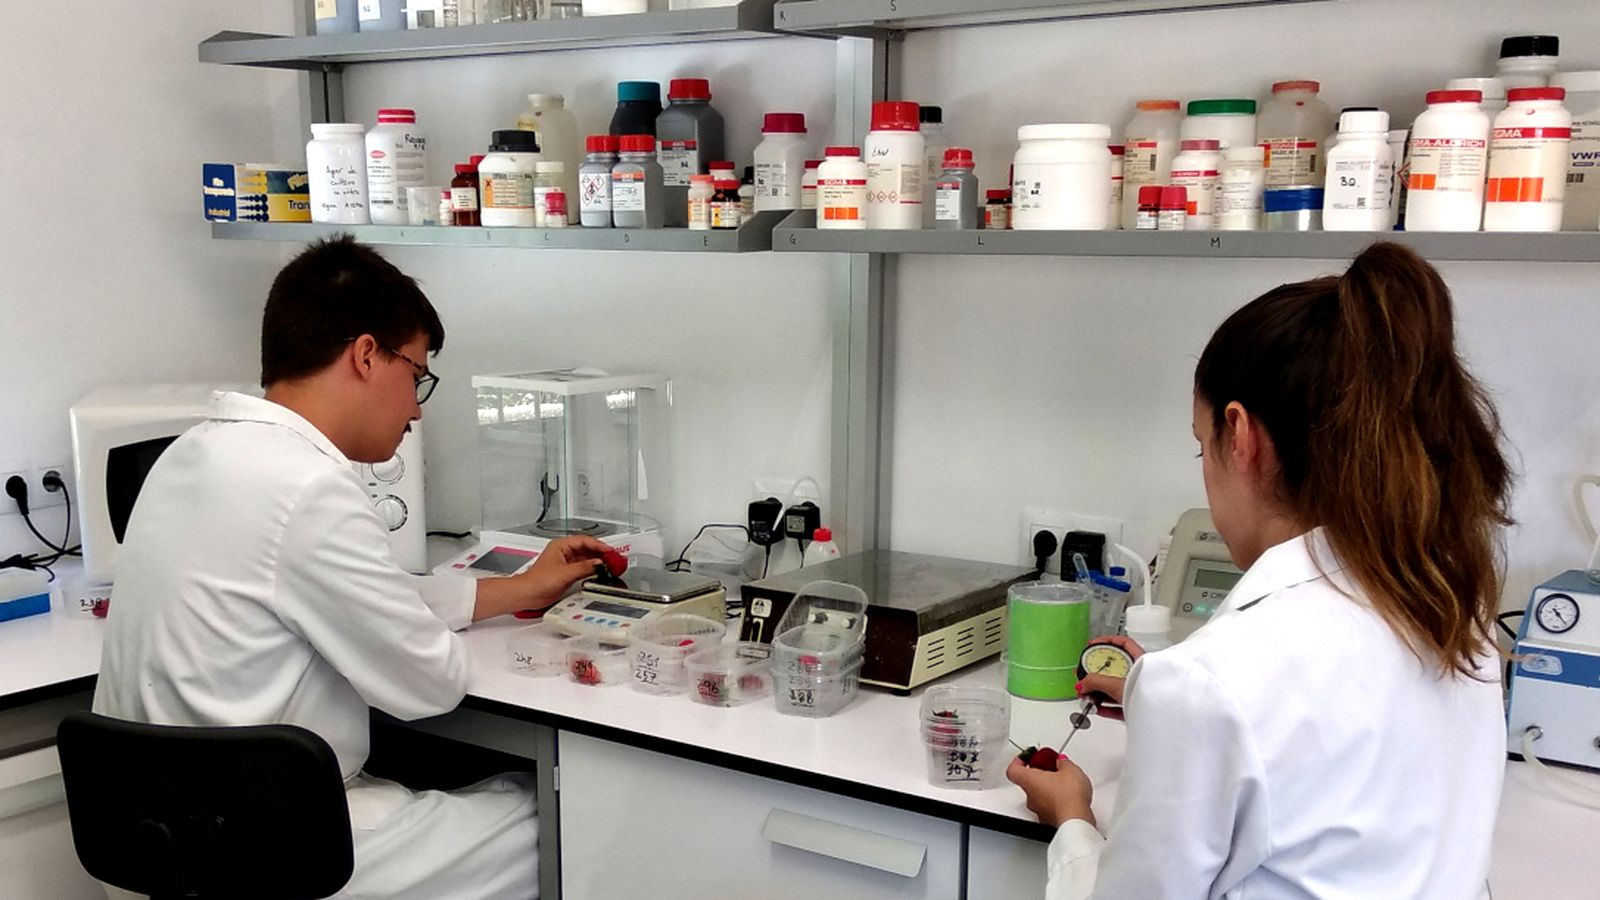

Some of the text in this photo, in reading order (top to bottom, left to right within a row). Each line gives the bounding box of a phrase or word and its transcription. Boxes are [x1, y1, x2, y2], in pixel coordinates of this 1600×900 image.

[789, 233, 796, 245] G
[977, 236, 985, 245] L
[1210, 236, 1221, 248] M
